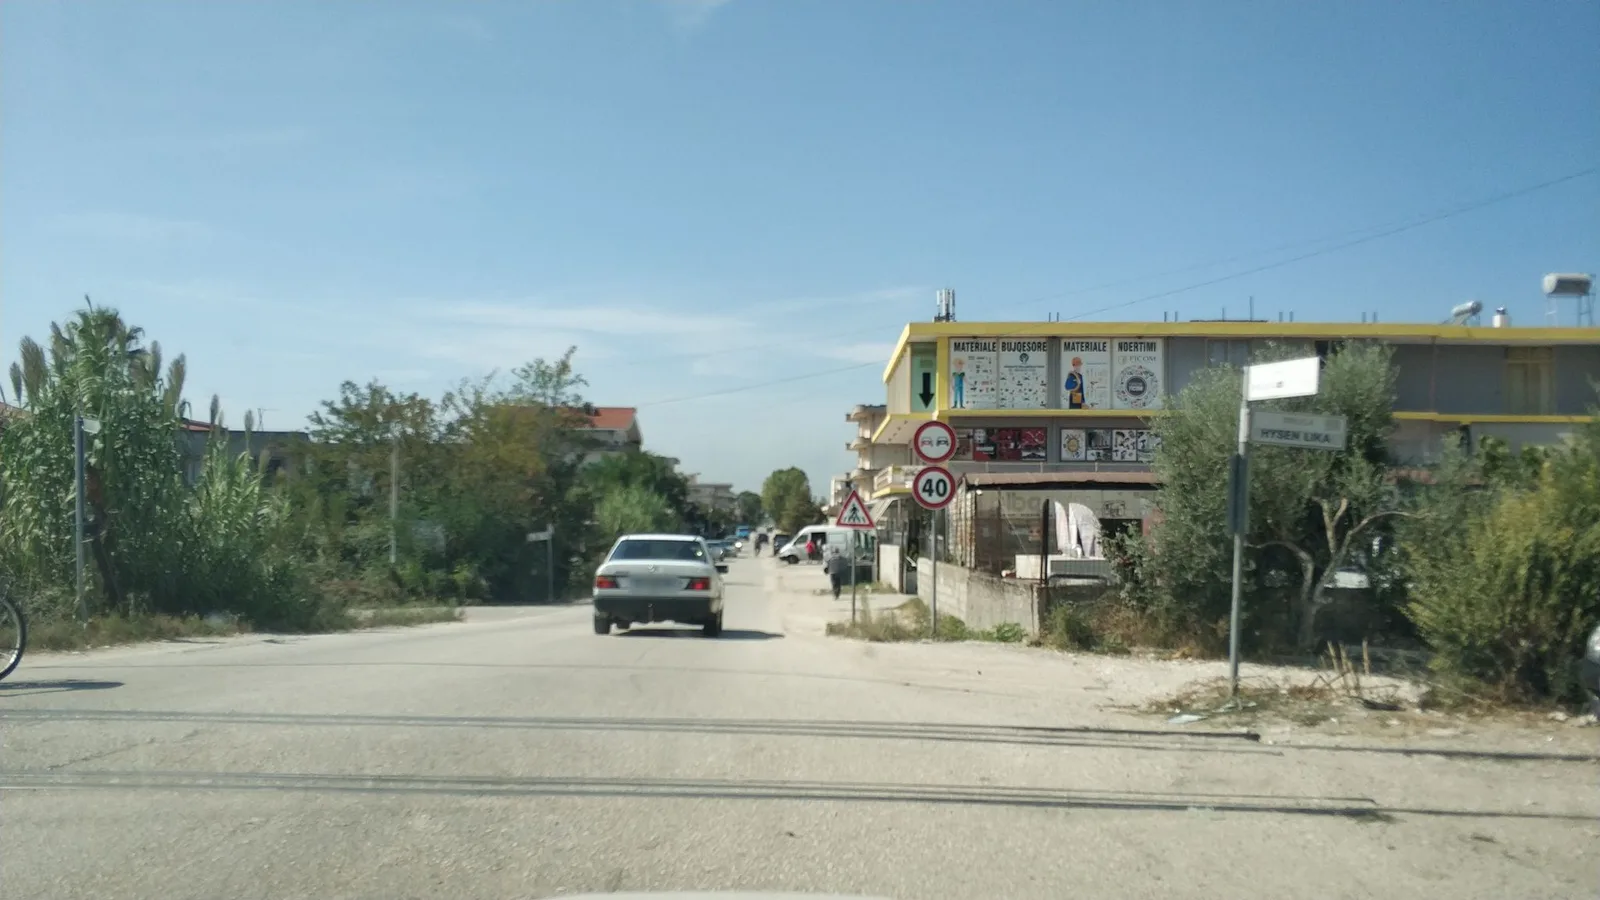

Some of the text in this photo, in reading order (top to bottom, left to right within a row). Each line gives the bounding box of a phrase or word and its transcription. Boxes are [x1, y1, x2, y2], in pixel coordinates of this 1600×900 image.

[954, 341, 1047, 352] MATERIALE BUJQESORE
[1064, 341, 1107, 352] MATERIALE
[922, 479, 947, 497] 40
